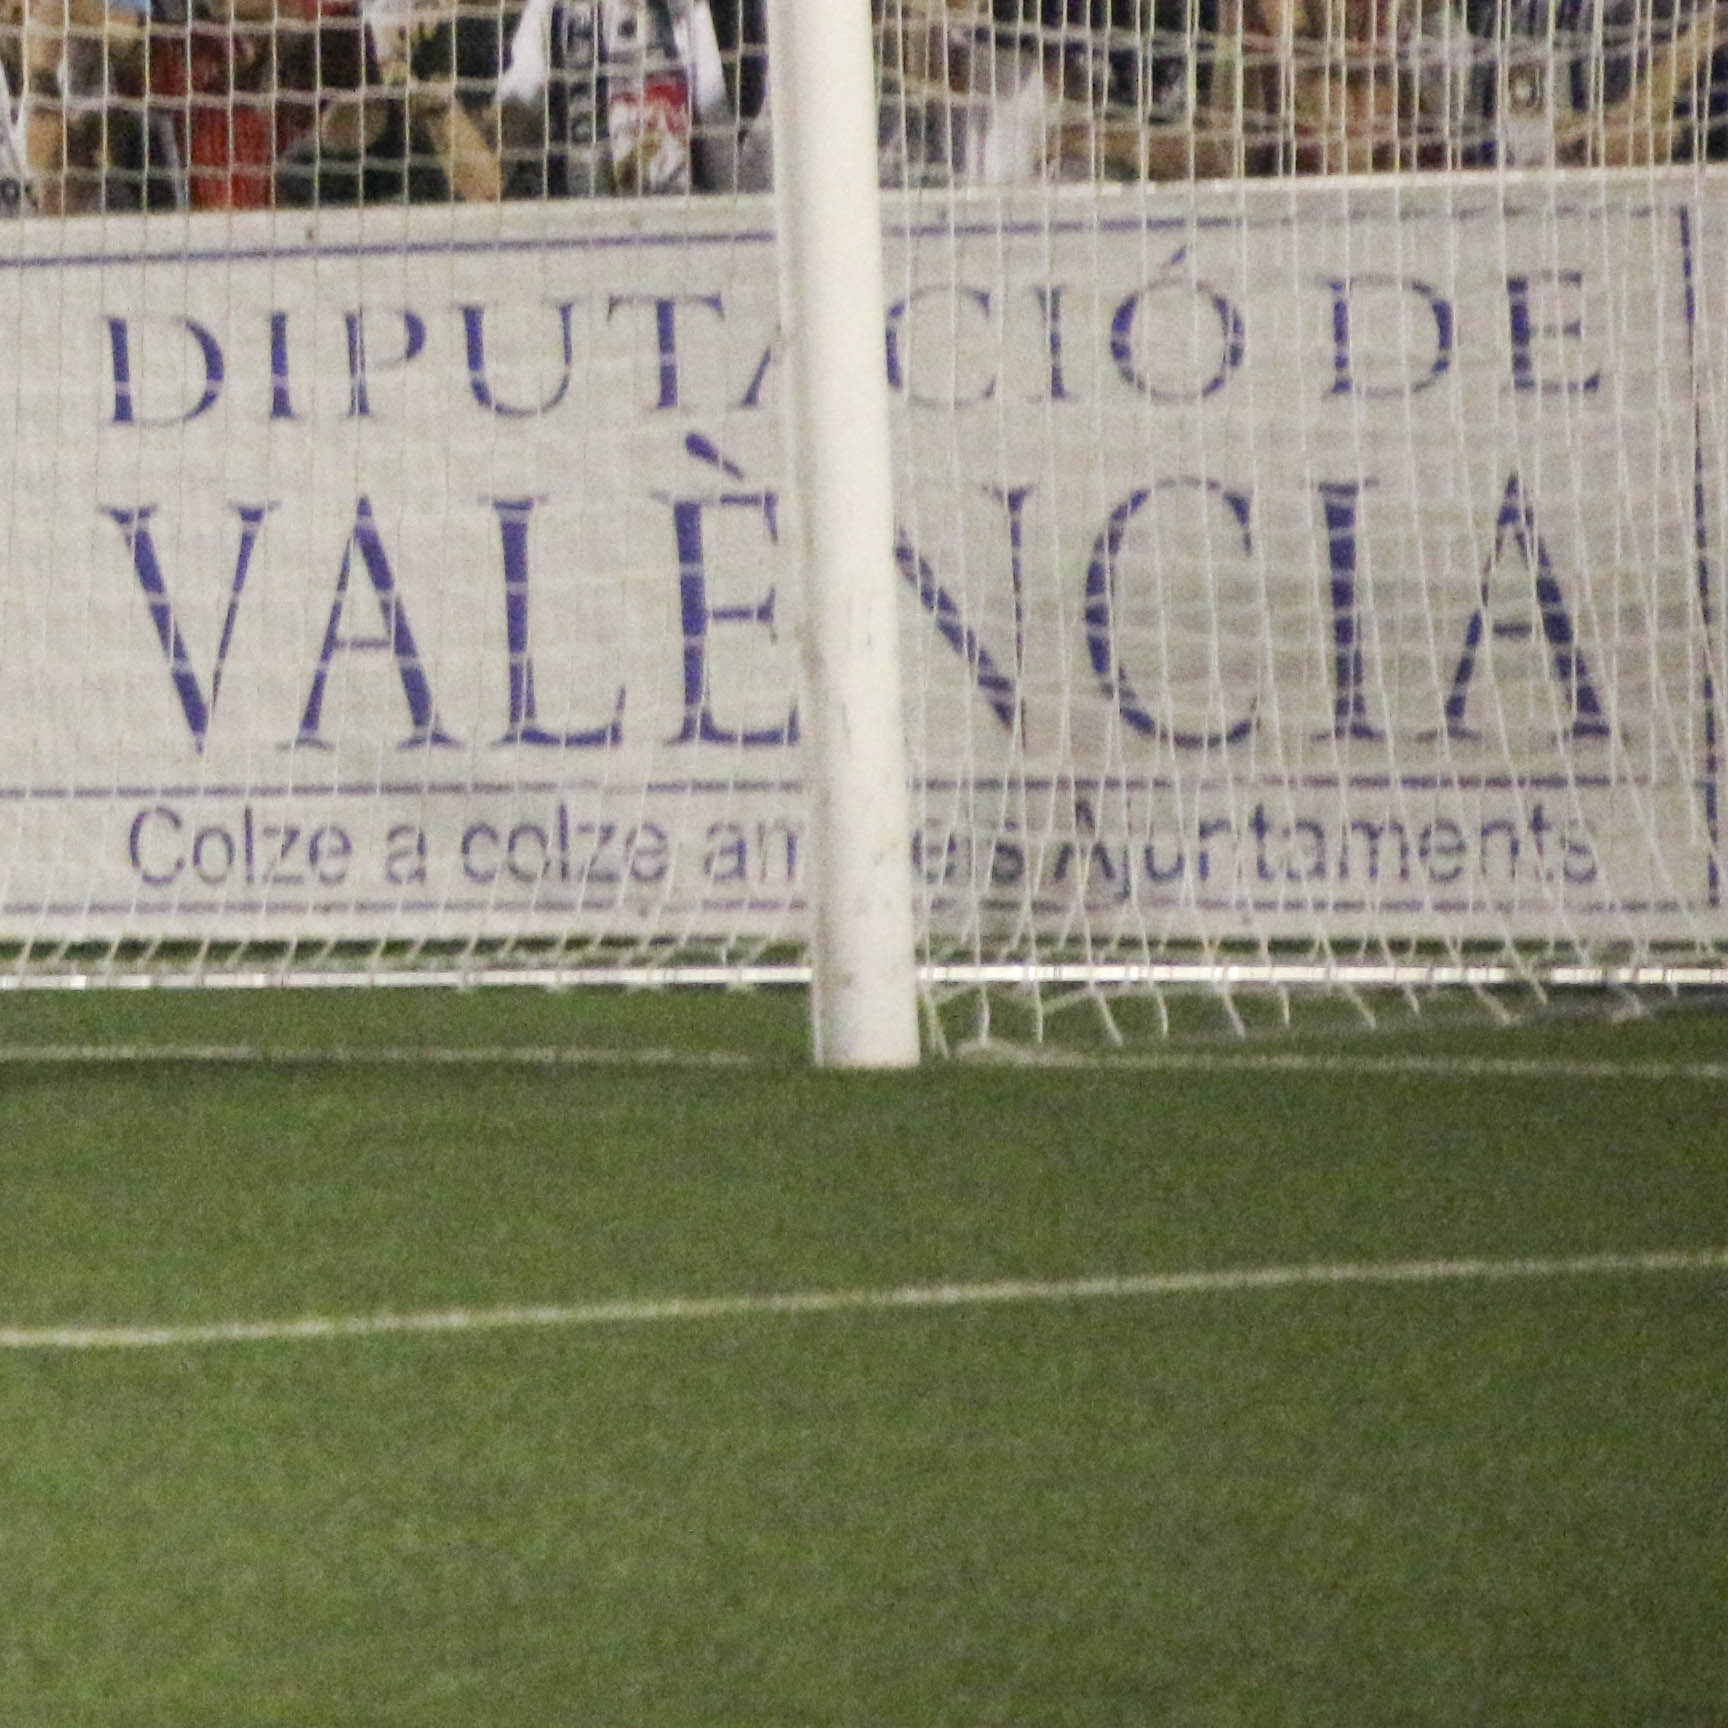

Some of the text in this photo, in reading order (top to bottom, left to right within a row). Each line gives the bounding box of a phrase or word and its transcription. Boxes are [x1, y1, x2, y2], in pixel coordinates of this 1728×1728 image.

[1320, 268, 1600, 400] DE
[100, 432, 1628, 755] VALÈNCIA
[128, 804, 352, 885] Colze
[385, 823, 428, 884] a
[461, 803, 670, 884] colze
